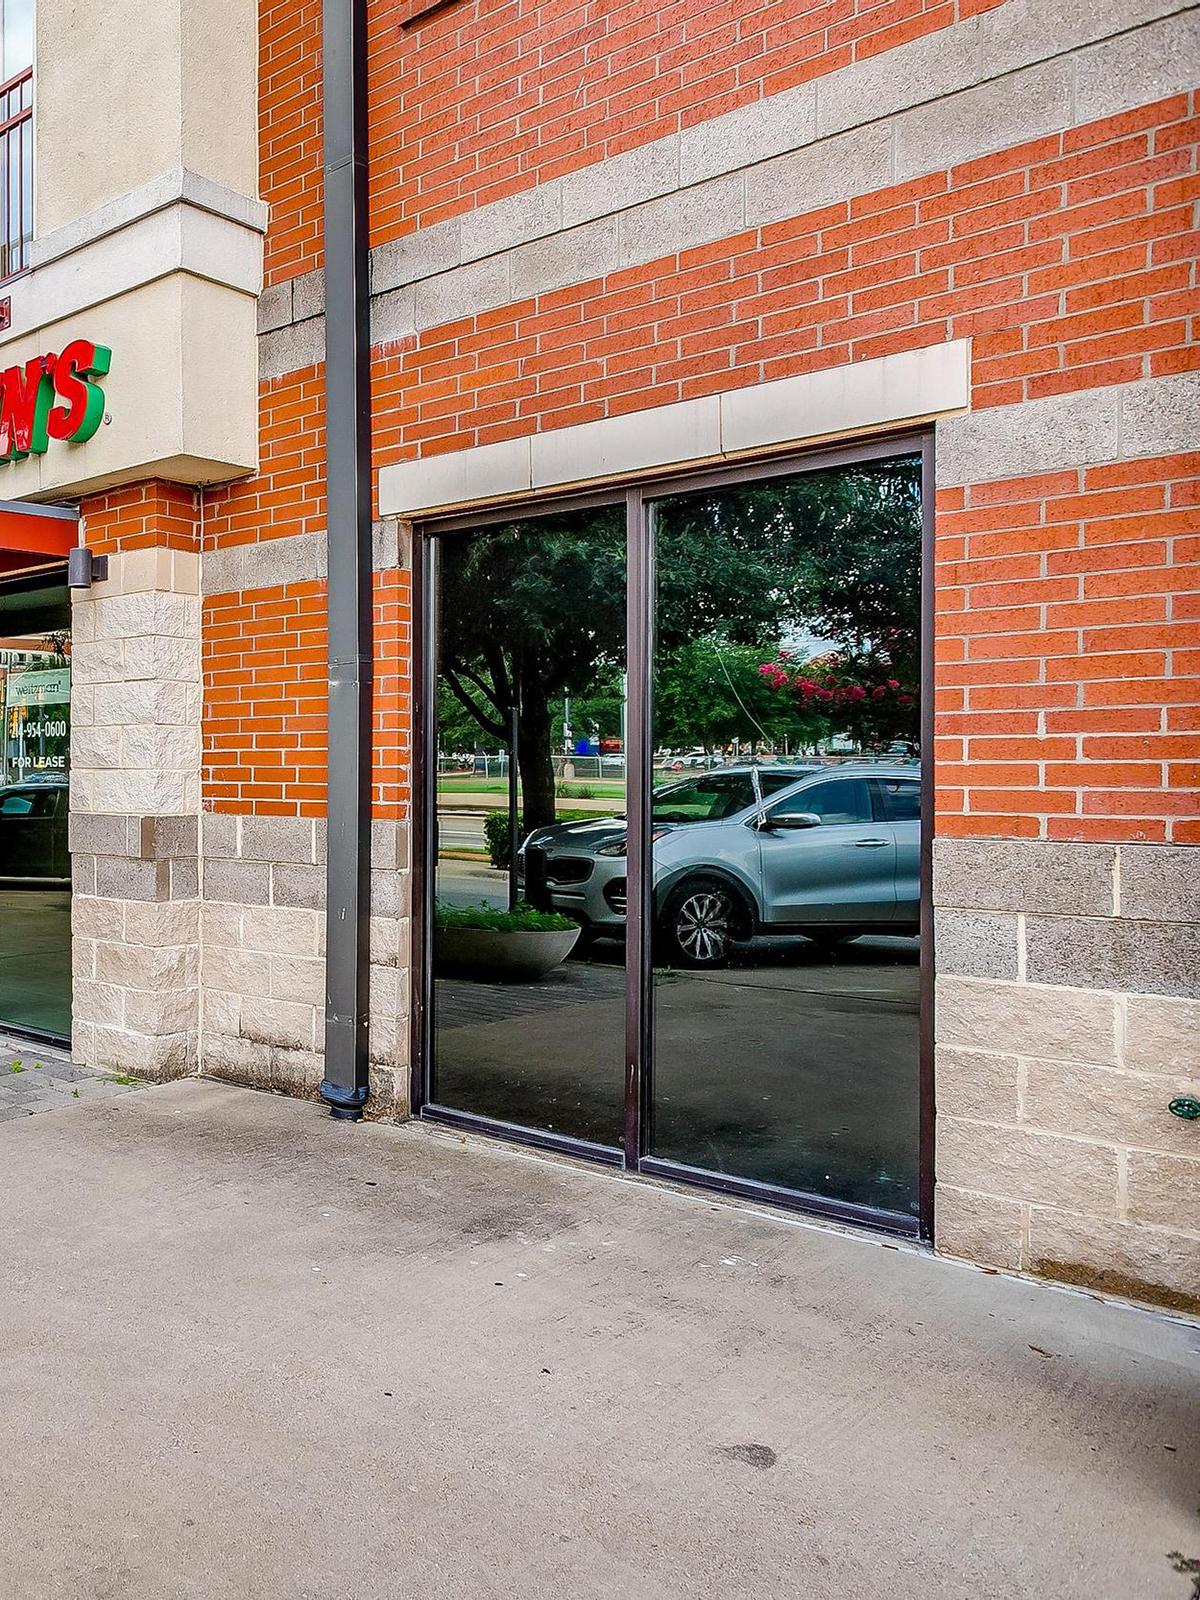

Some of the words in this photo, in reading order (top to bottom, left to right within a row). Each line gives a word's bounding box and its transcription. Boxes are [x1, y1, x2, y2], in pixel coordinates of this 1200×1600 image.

[11, 721, 66, 738] 214-954-0600
[12, 757, 31, 768] FOR
[33, 756, 65, 768] LEASE
